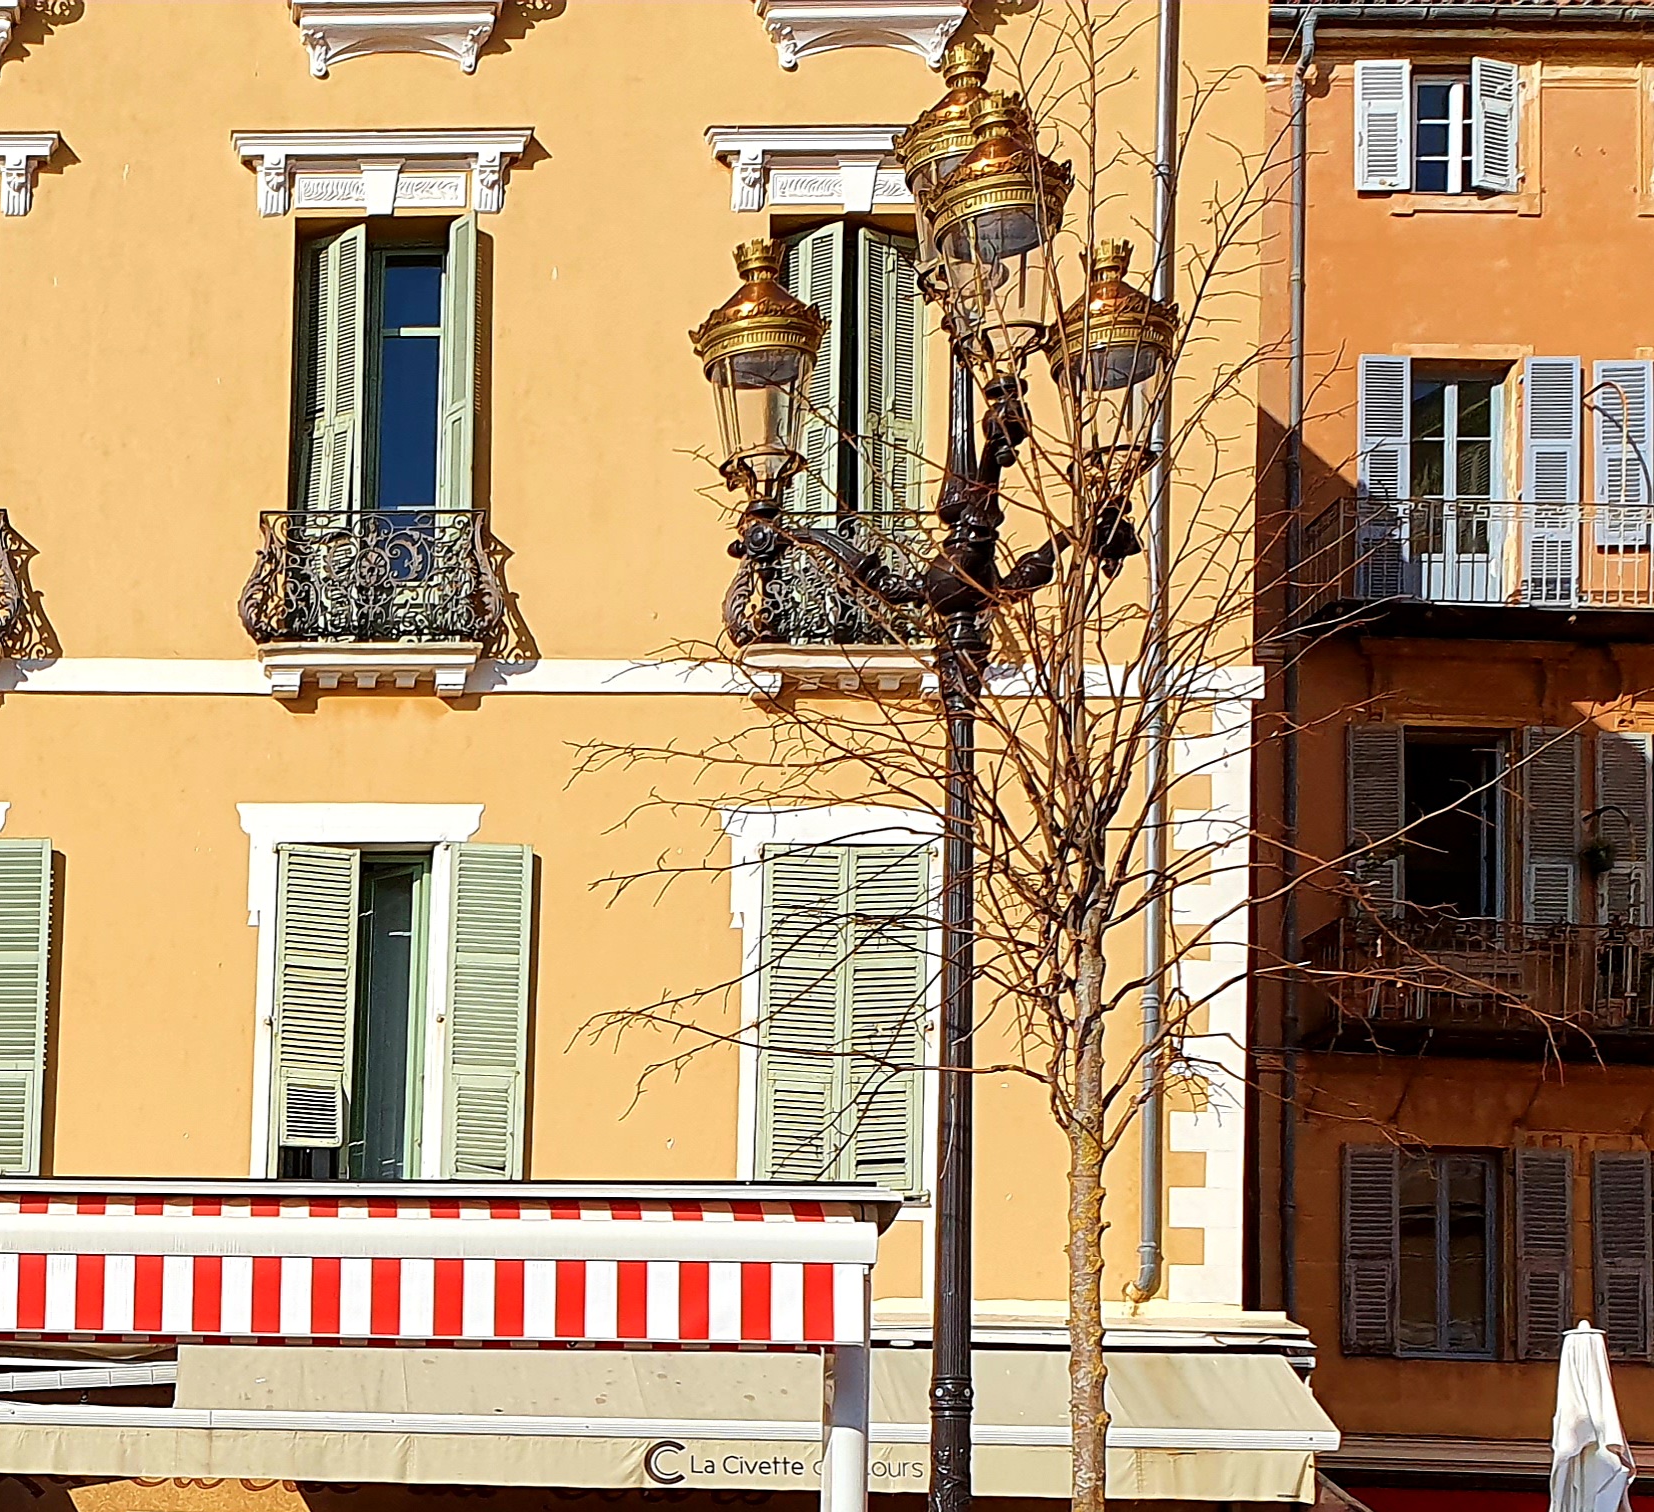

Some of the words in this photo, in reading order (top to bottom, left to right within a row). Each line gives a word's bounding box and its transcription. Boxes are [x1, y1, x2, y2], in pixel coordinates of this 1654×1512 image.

[690, 1455, 715, 1474] La
[723, 1455, 805, 1475] Civette
[868, 1460, 924, 1478] ours
